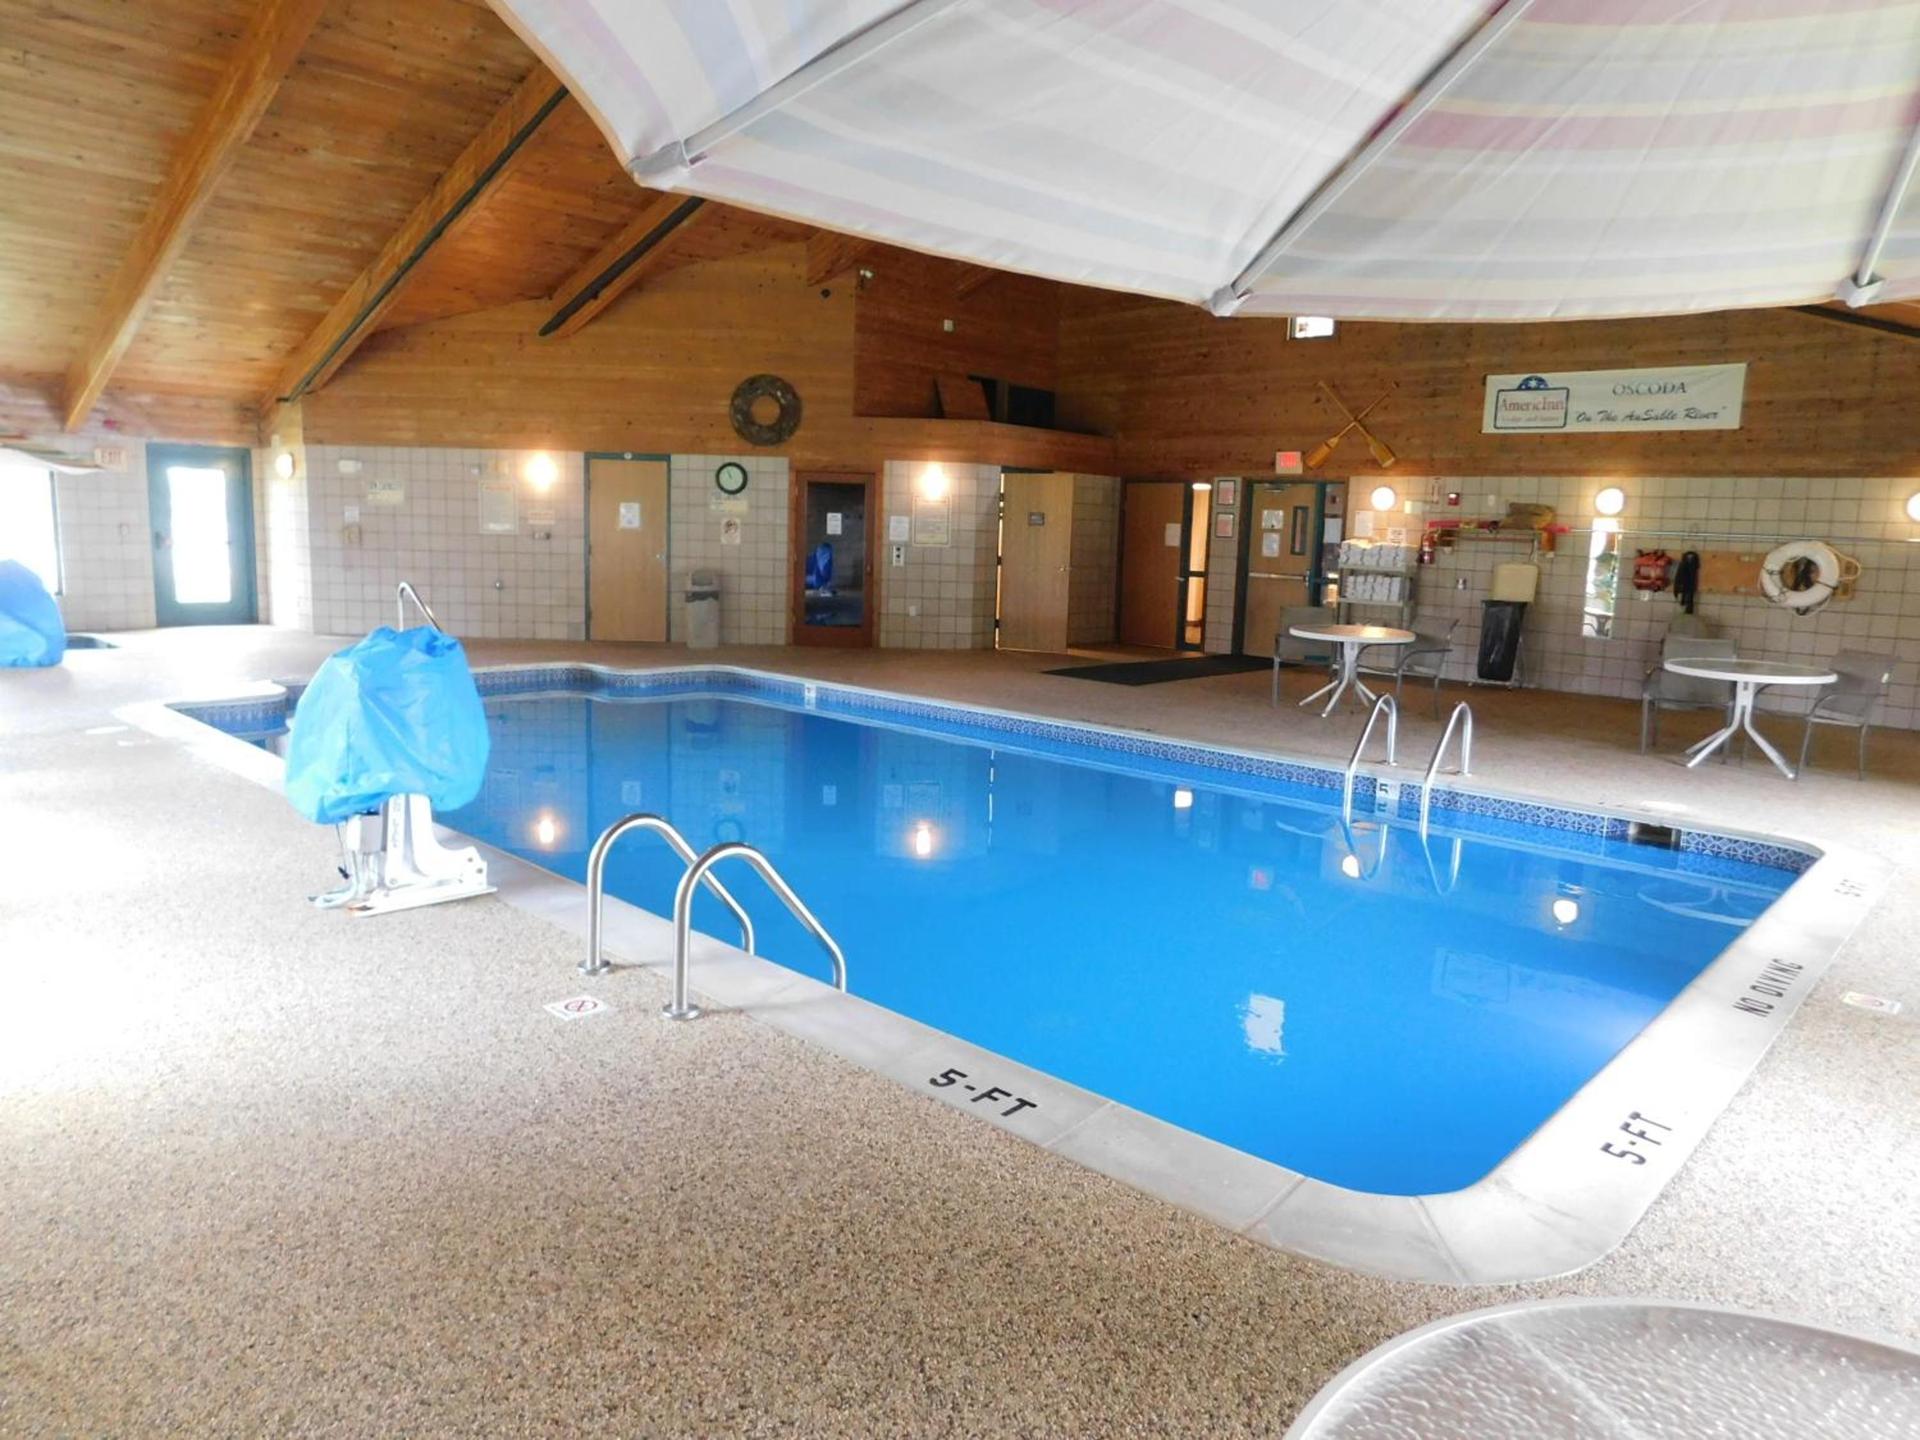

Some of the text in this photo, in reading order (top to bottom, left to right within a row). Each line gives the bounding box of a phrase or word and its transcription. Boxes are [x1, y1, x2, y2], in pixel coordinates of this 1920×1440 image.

[1502, 396, 1565, 411] AmericInn
[1612, 382, 1687, 396] OSCODA
[1732, 959, 1804, 1018] NO DIVING
[929, 1068, 1037, 1116] 5-FT
[1600, 1111, 1672, 1165] 5-FT
